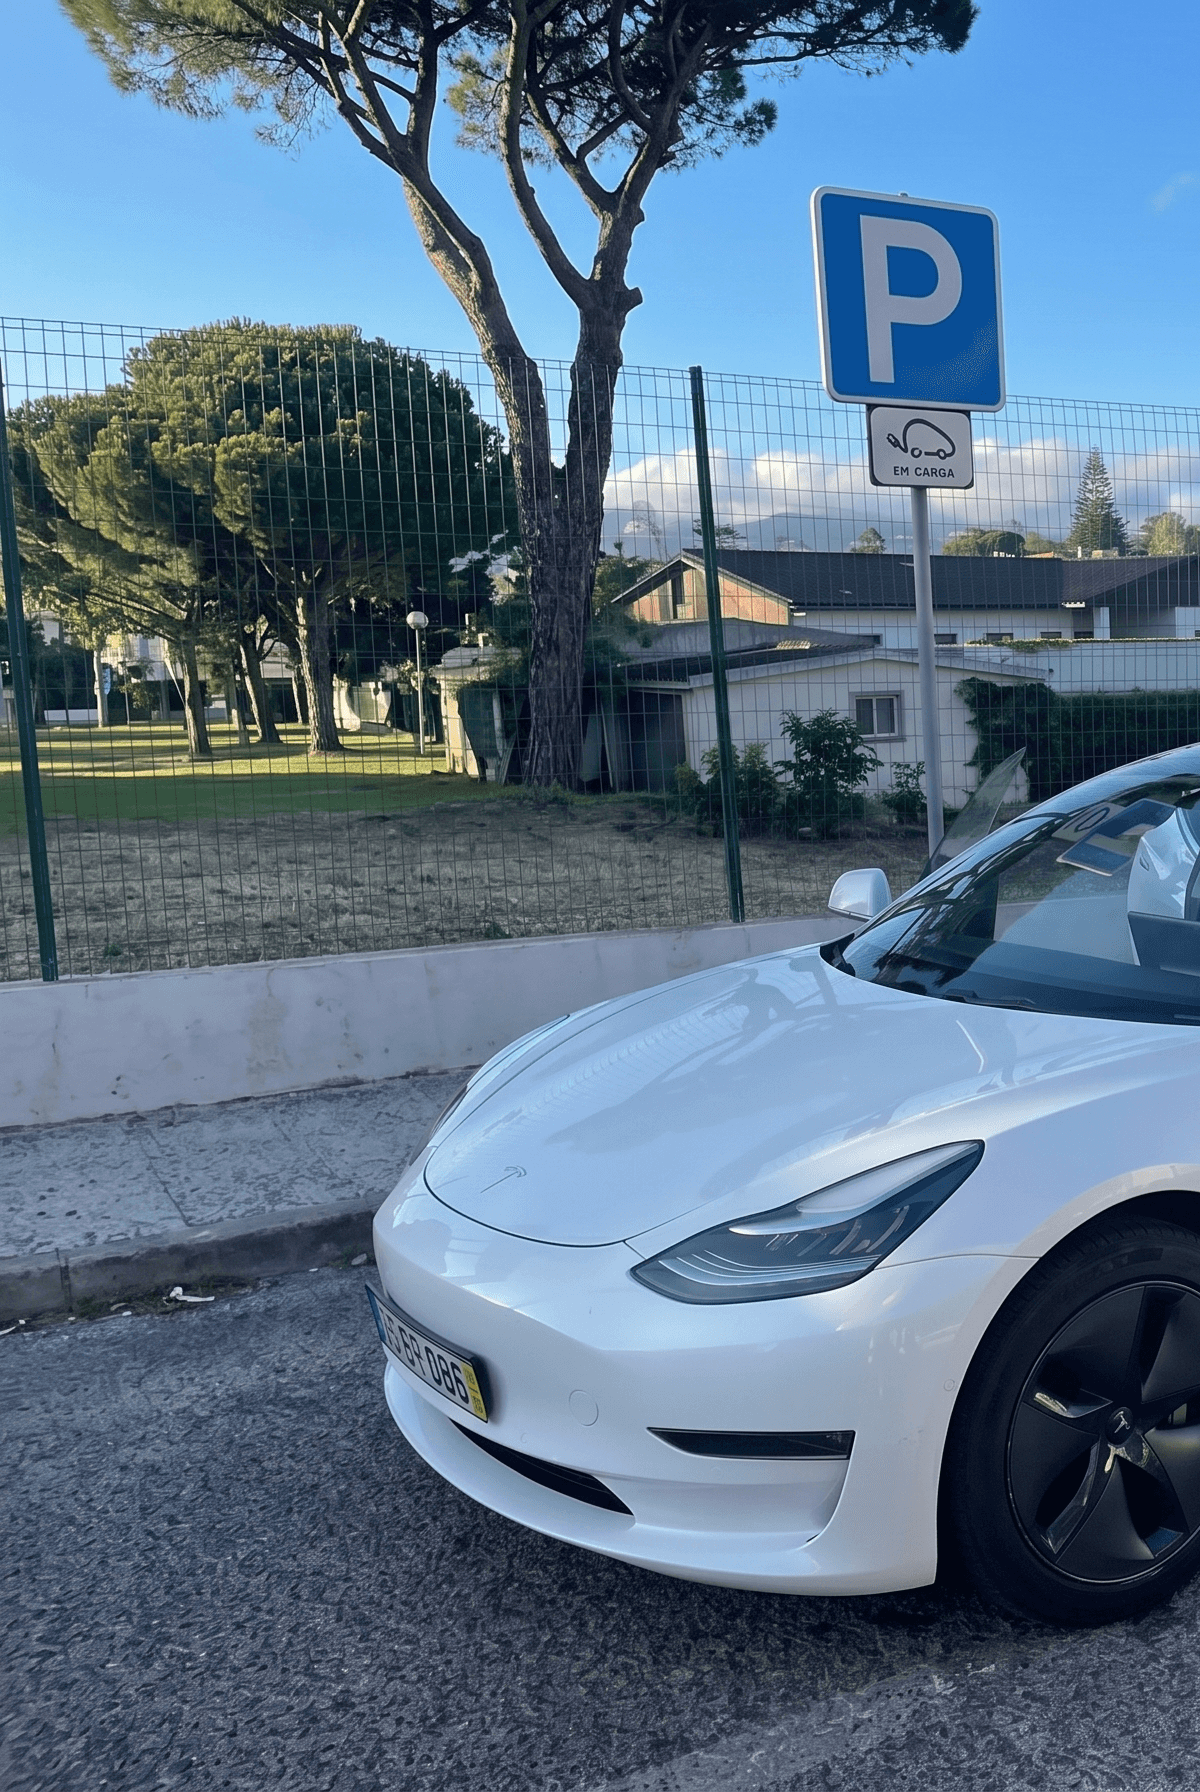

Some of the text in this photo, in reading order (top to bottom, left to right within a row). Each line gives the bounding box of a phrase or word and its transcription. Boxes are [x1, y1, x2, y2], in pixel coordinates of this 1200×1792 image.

[860, 214, 962, 383] P
[893, 466, 955, 478] EM CARGA
